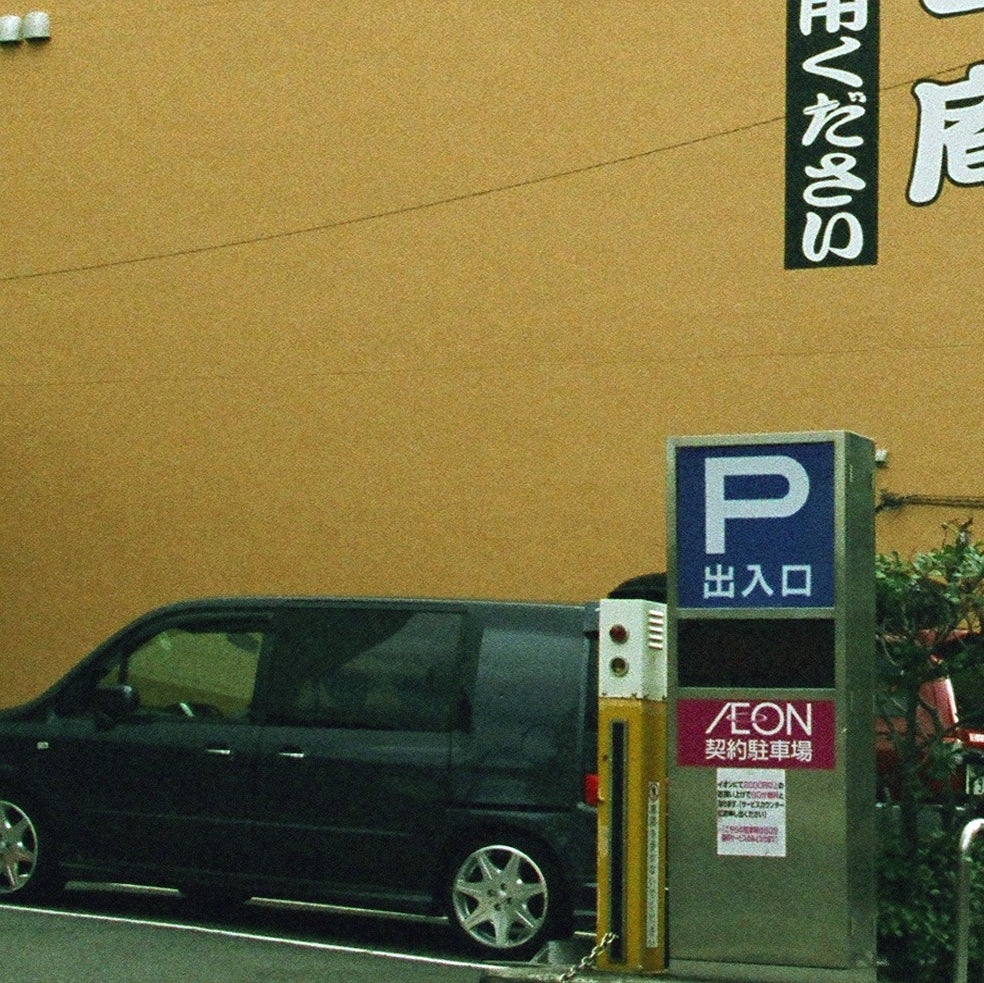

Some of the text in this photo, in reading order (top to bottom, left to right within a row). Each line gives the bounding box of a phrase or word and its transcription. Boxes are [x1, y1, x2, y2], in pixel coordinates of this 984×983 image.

[704, 454, 810, 555] P
[702, 563, 812, 600] 出入口
[705, 738, 813, 763] 契約駐車場
